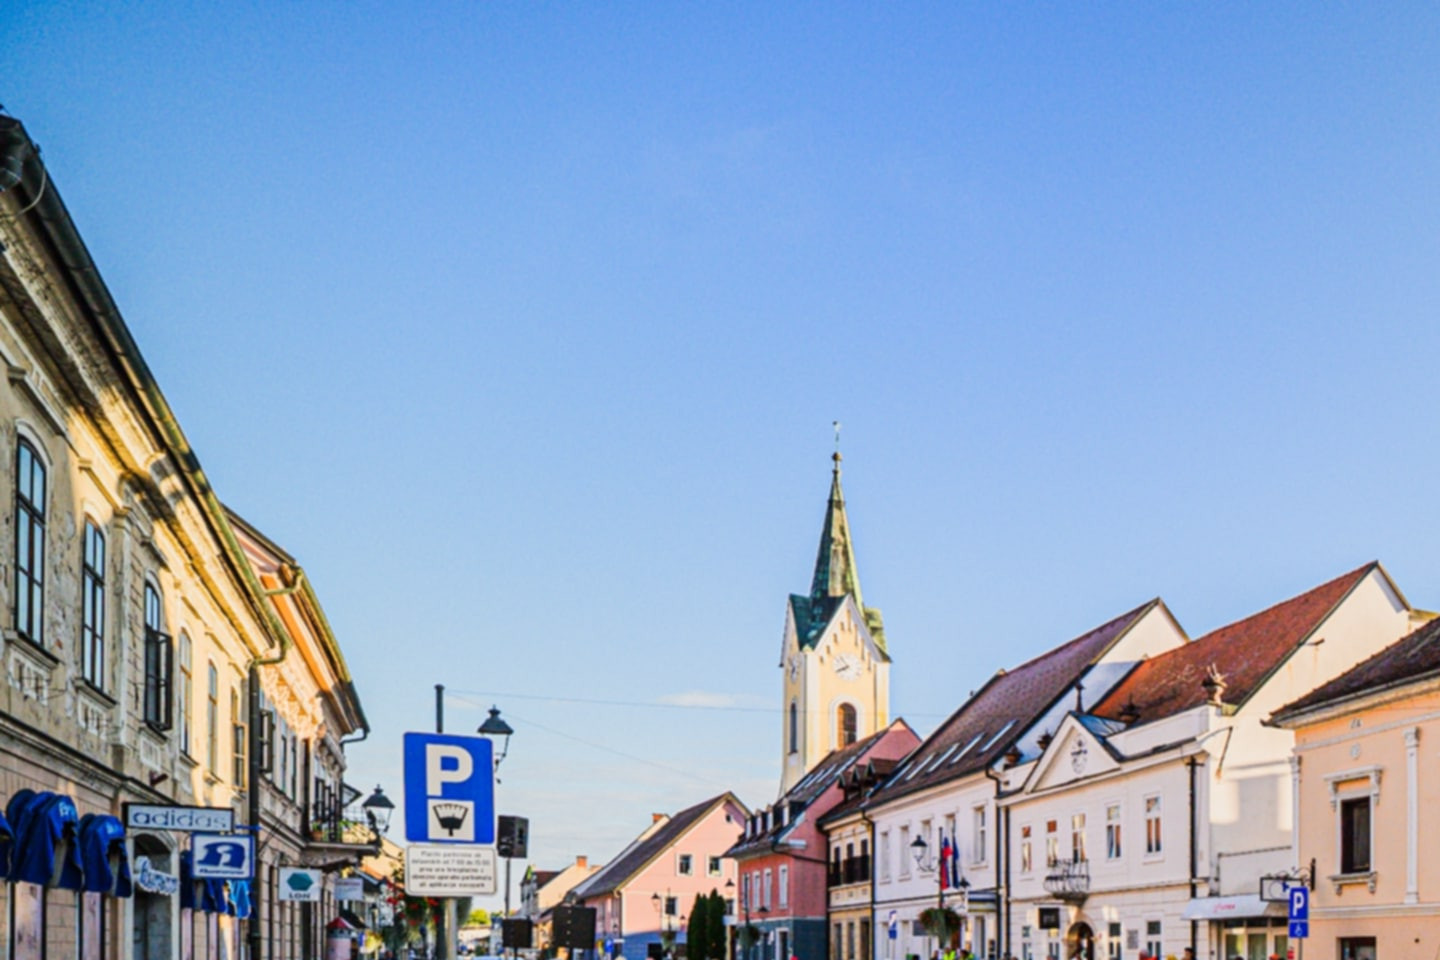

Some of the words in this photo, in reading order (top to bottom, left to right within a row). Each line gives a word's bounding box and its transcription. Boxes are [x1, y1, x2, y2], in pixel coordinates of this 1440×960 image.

[426, 743, 473, 796] P
[133, 810, 226, 828] adidas
[1292, 892, 1305, 916] P
